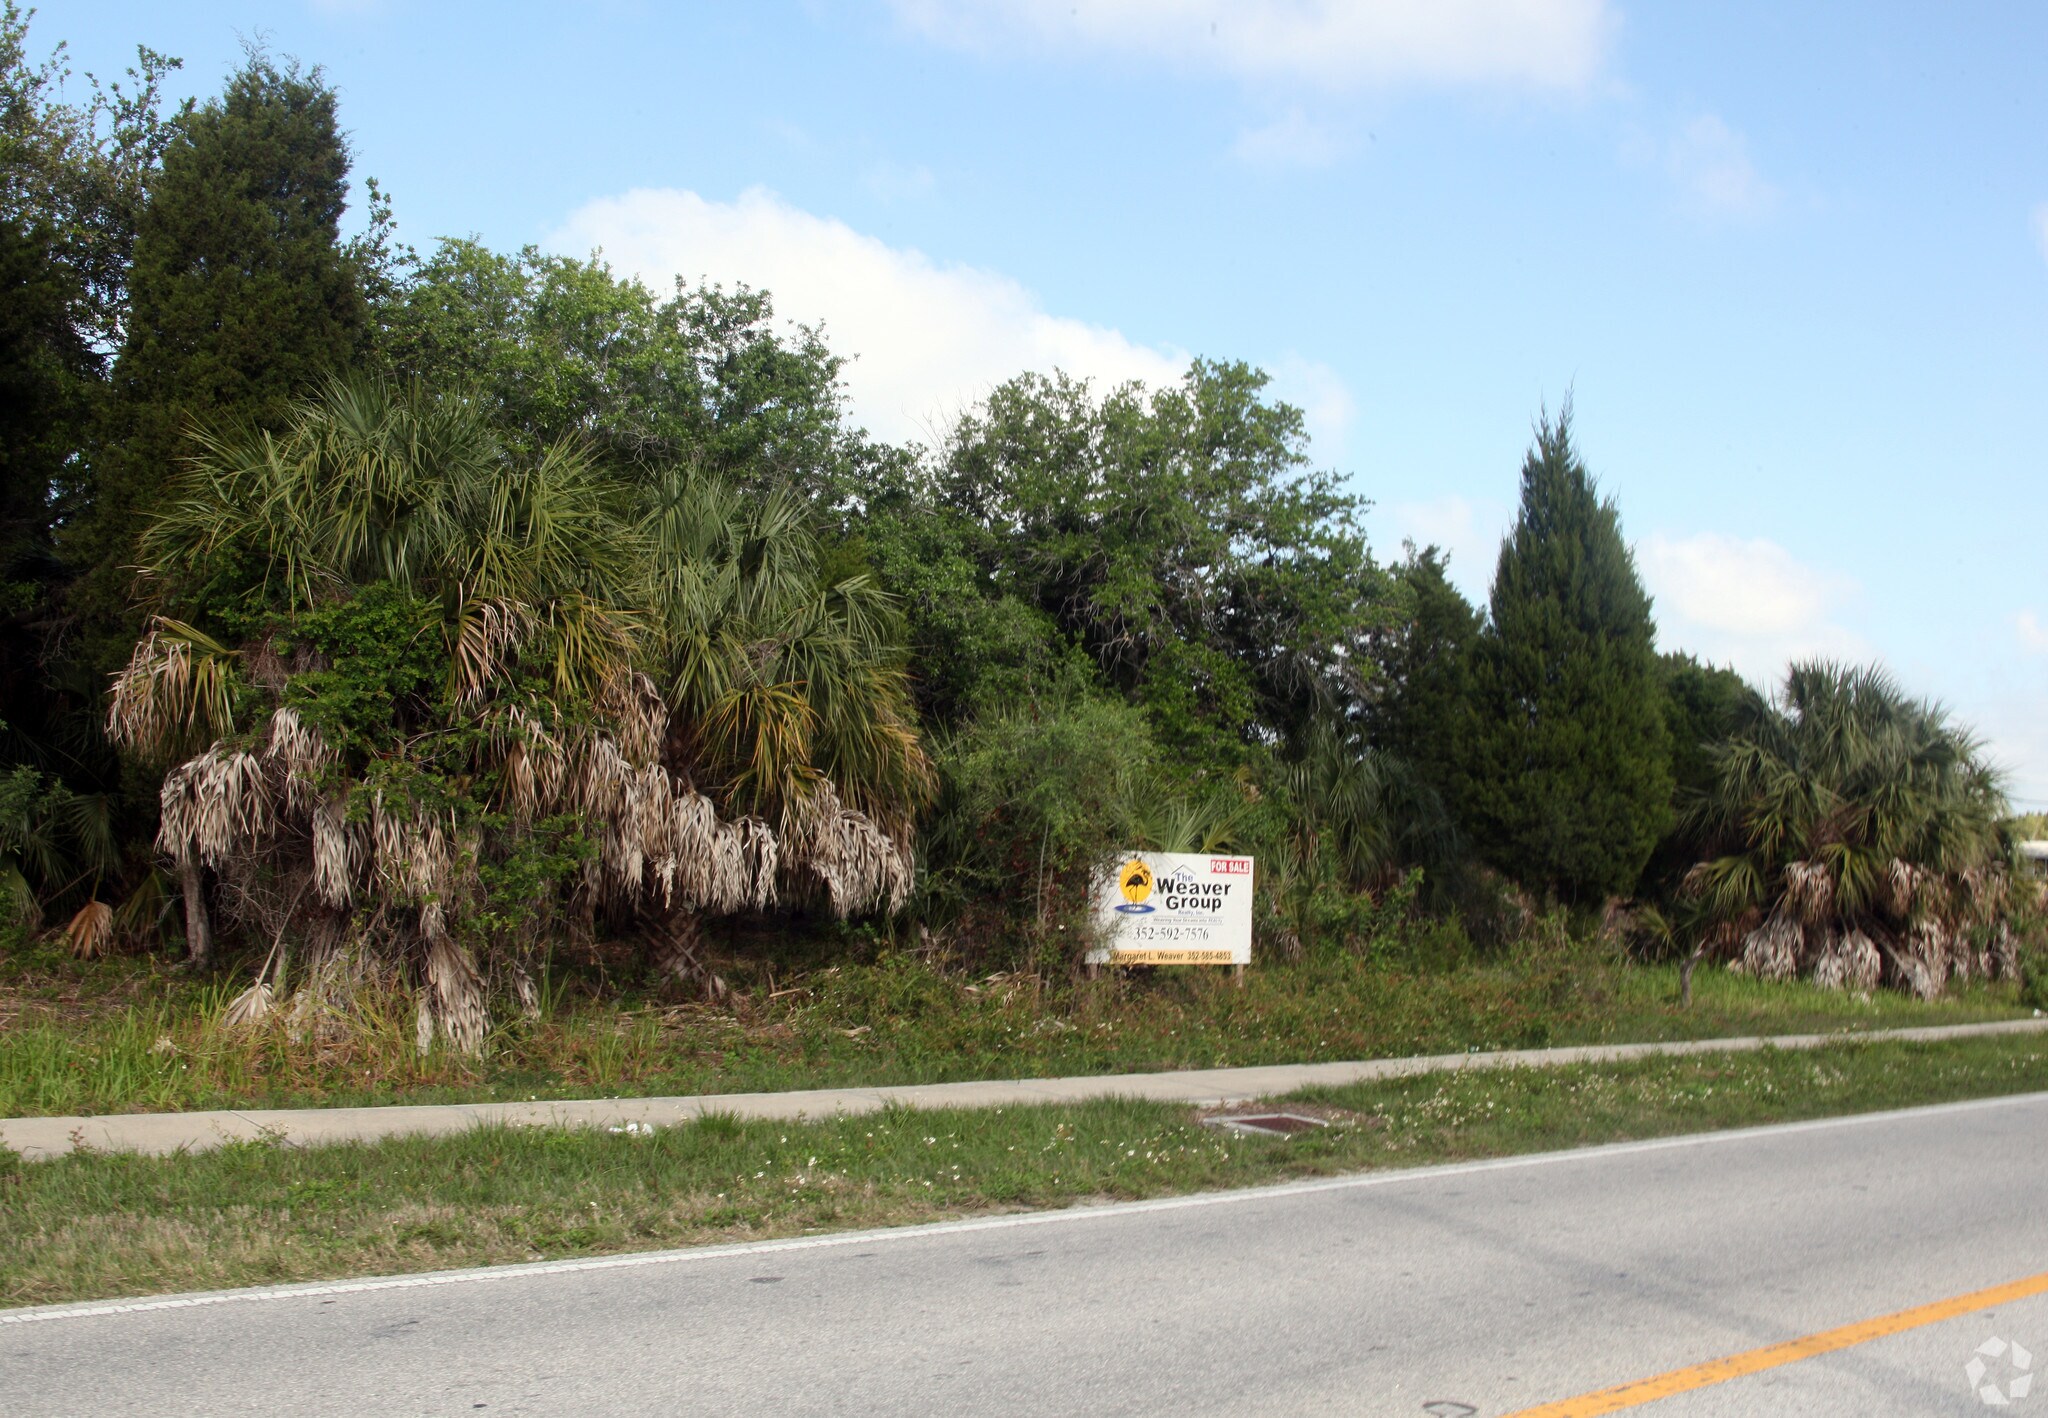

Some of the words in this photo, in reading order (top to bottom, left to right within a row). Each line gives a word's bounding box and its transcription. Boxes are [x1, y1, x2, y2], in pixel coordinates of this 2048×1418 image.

[1211, 861, 1227, 872] FOR
[1229, 862, 1249, 873] SALE
[1175, 872, 1193, 882] The
[1157, 878, 1231, 895] Weaver
[1166, 896, 1222, 912] Group
[1134, 927, 1209, 940] 352-592-7576
[1114, 951, 1146, 961] Margaret
[1157, 951, 1184, 960] Weaver
